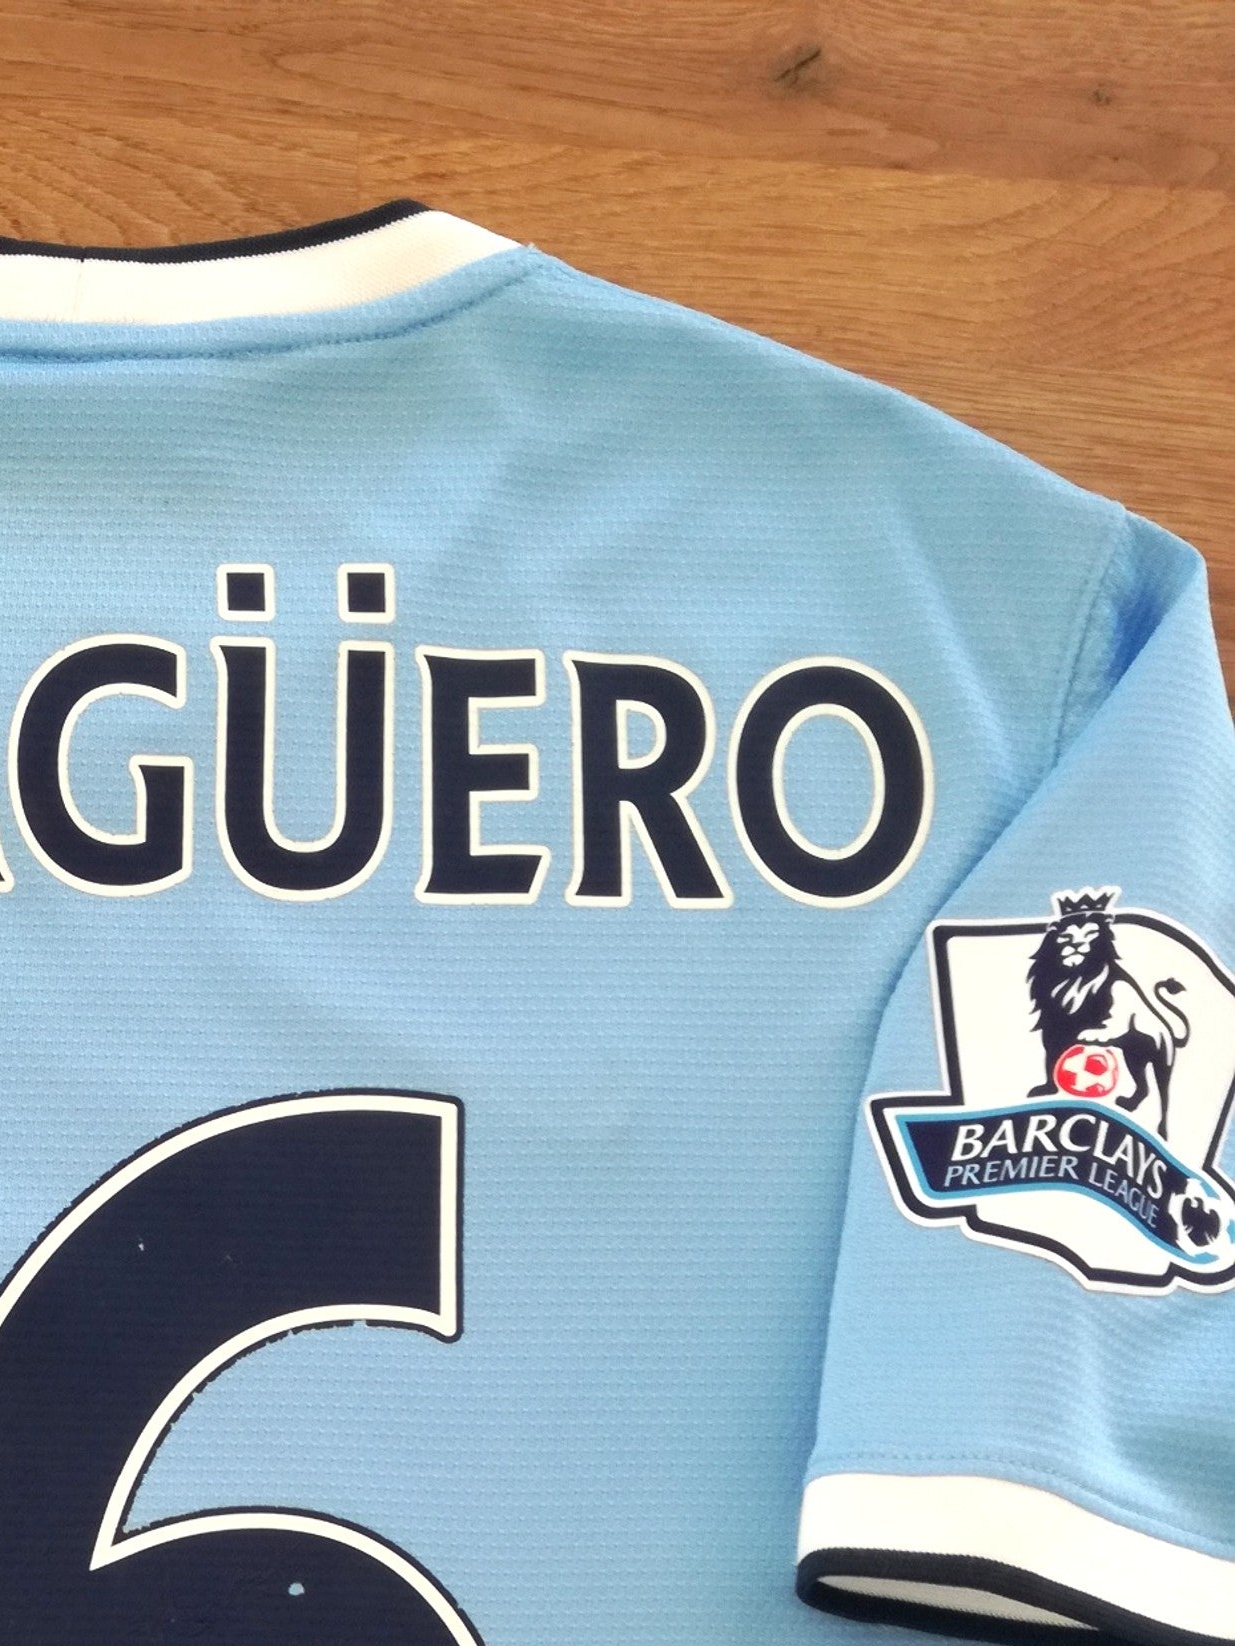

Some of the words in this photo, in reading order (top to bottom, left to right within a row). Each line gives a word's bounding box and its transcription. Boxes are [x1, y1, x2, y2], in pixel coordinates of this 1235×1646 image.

[944, 1155, 1079, 1188] PREMIER
[1088, 1162, 1159, 1228] LEAGUE
[951, 1113, 1167, 1199] BARCLAYS
